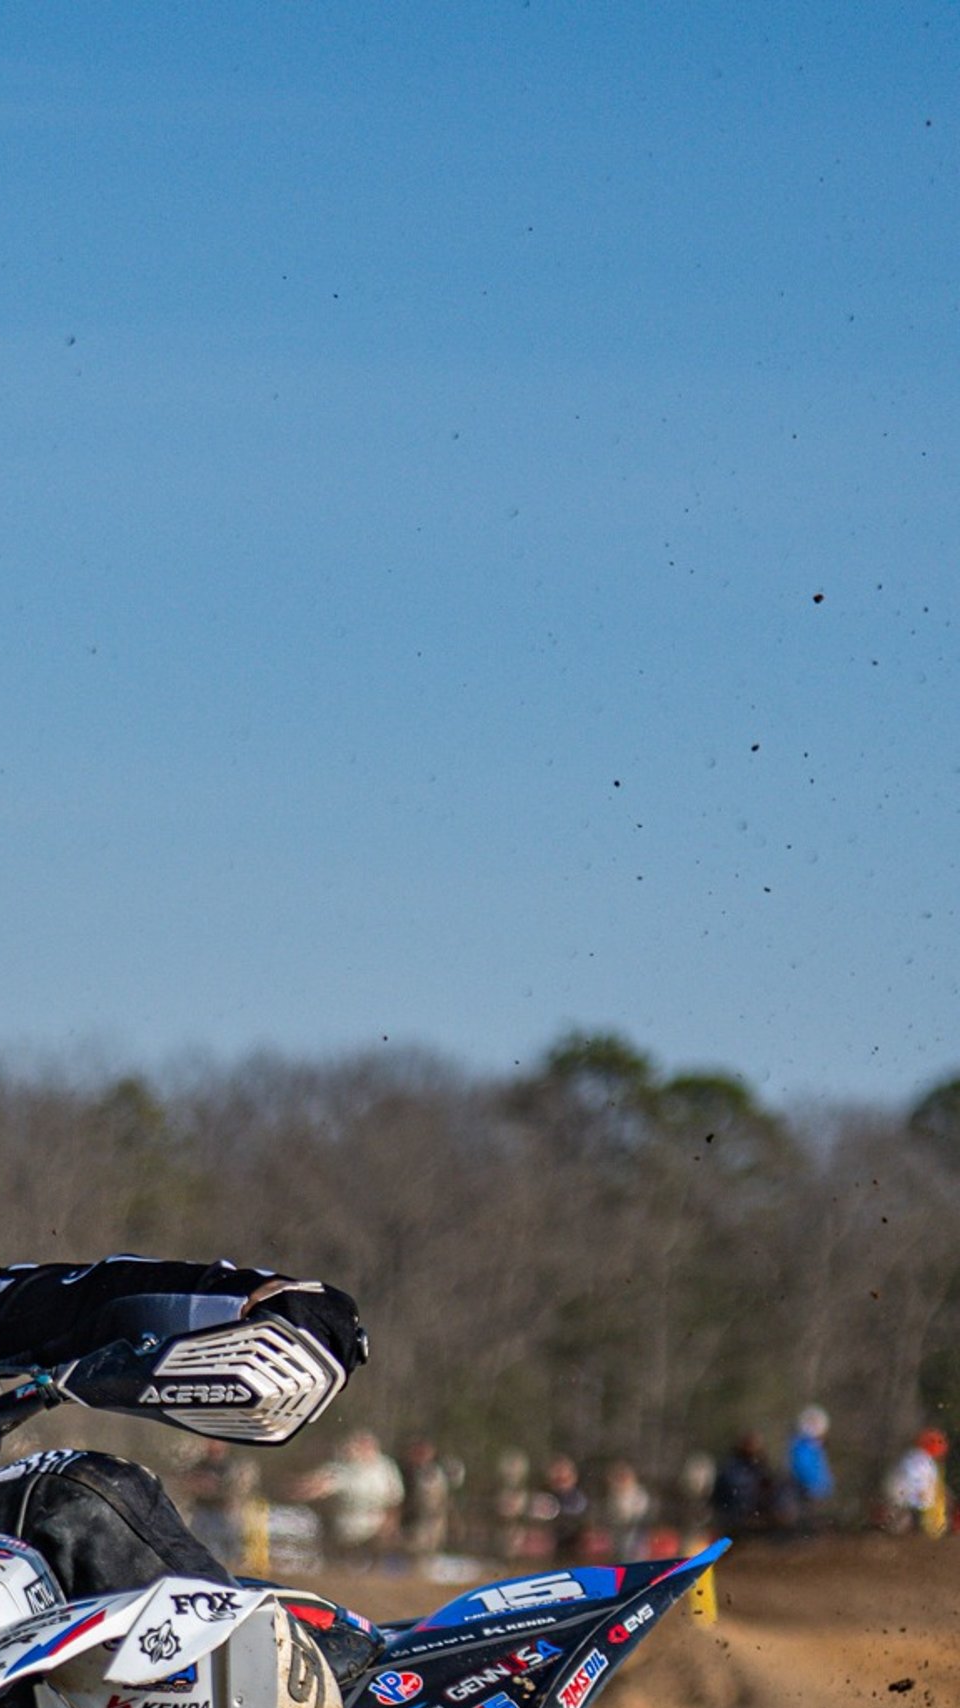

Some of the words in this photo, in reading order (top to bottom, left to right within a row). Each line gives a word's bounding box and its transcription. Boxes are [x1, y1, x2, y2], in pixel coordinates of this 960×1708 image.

[170, 1591, 242, 1622] FOX
[468, 1571, 586, 1611] 15
[506, 1616, 557, 1631] KENDA
